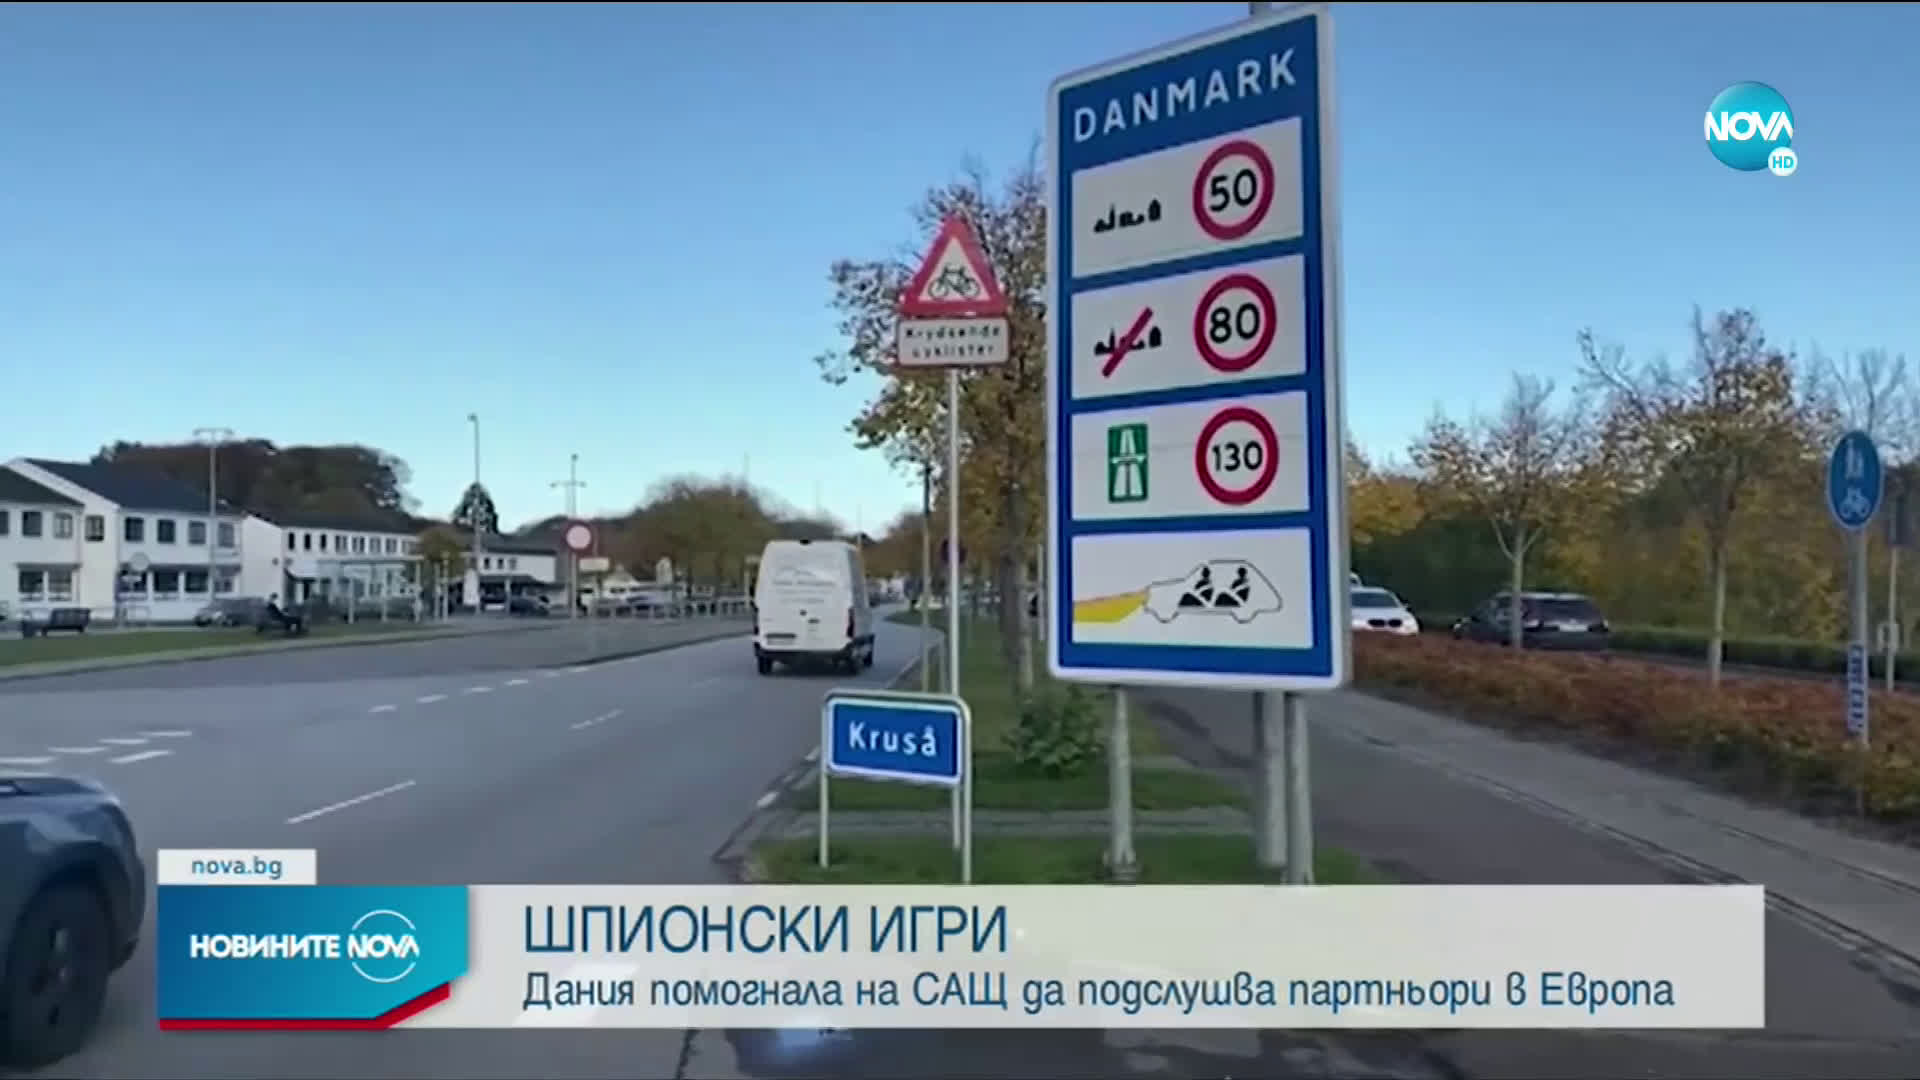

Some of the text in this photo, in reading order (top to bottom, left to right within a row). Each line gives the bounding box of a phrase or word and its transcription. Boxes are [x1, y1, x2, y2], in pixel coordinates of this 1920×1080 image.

[1073, 48, 1297, 143] DANMARK
[1209, 168, 1258, 213] 50
[1209, 302, 1261, 345] 80
[1211, 440, 1264, 473] 130
[849, 720, 938, 758] Kruså
